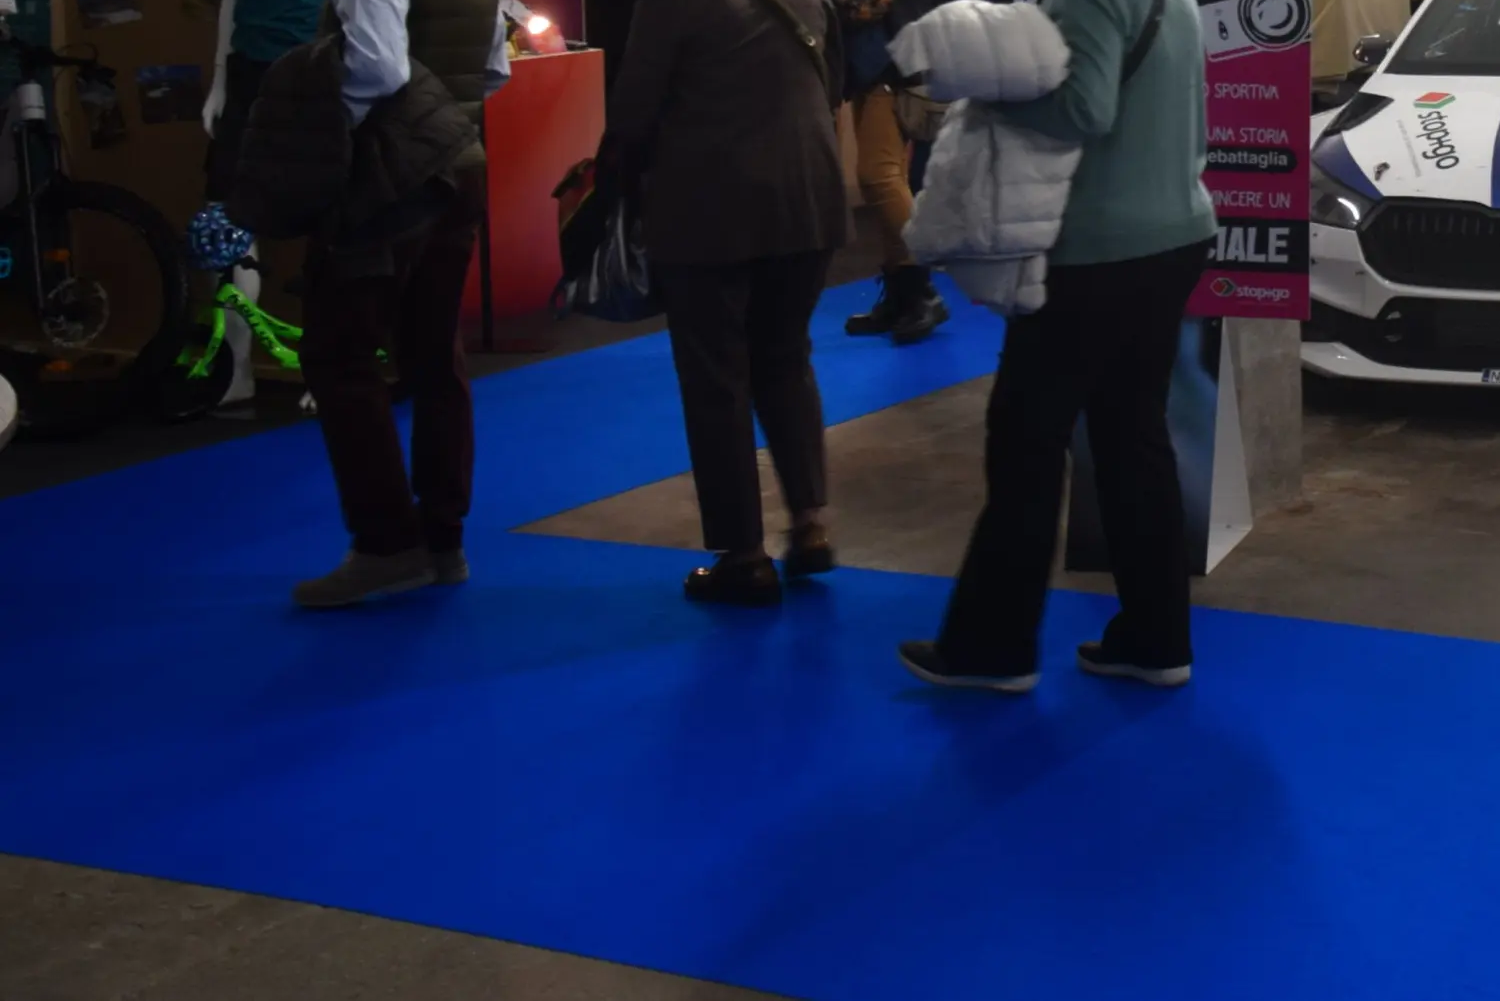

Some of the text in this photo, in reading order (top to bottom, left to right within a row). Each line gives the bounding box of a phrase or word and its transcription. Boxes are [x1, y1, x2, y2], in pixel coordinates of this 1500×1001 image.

[1214, 83, 1279, 99] SPORTIVA
[1240, 127, 1288, 144] STORIA
[1207, 149, 1288, 168] ebattaglia
[1268, 193, 1291, 209] UN
